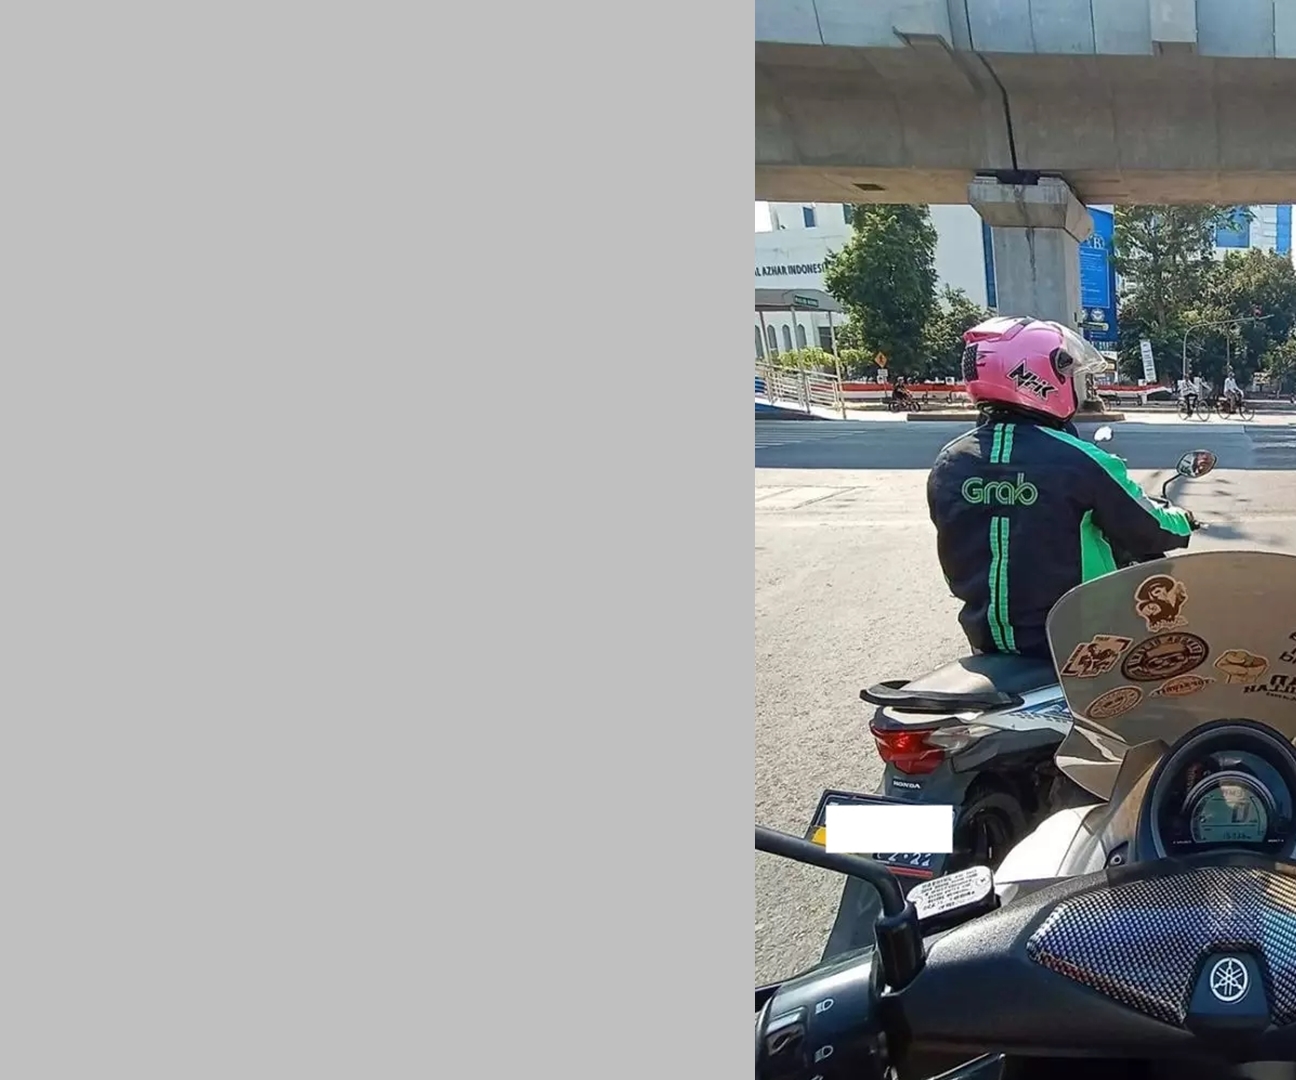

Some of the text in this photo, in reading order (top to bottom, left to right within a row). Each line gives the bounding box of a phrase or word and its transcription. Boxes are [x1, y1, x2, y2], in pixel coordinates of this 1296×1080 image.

[762, 265, 788, 276] AZHAR
[1007, 359, 1059, 400] NHK
[961, 472, 1039, 506] Grab
[893, 780, 921, 789] HONDA
